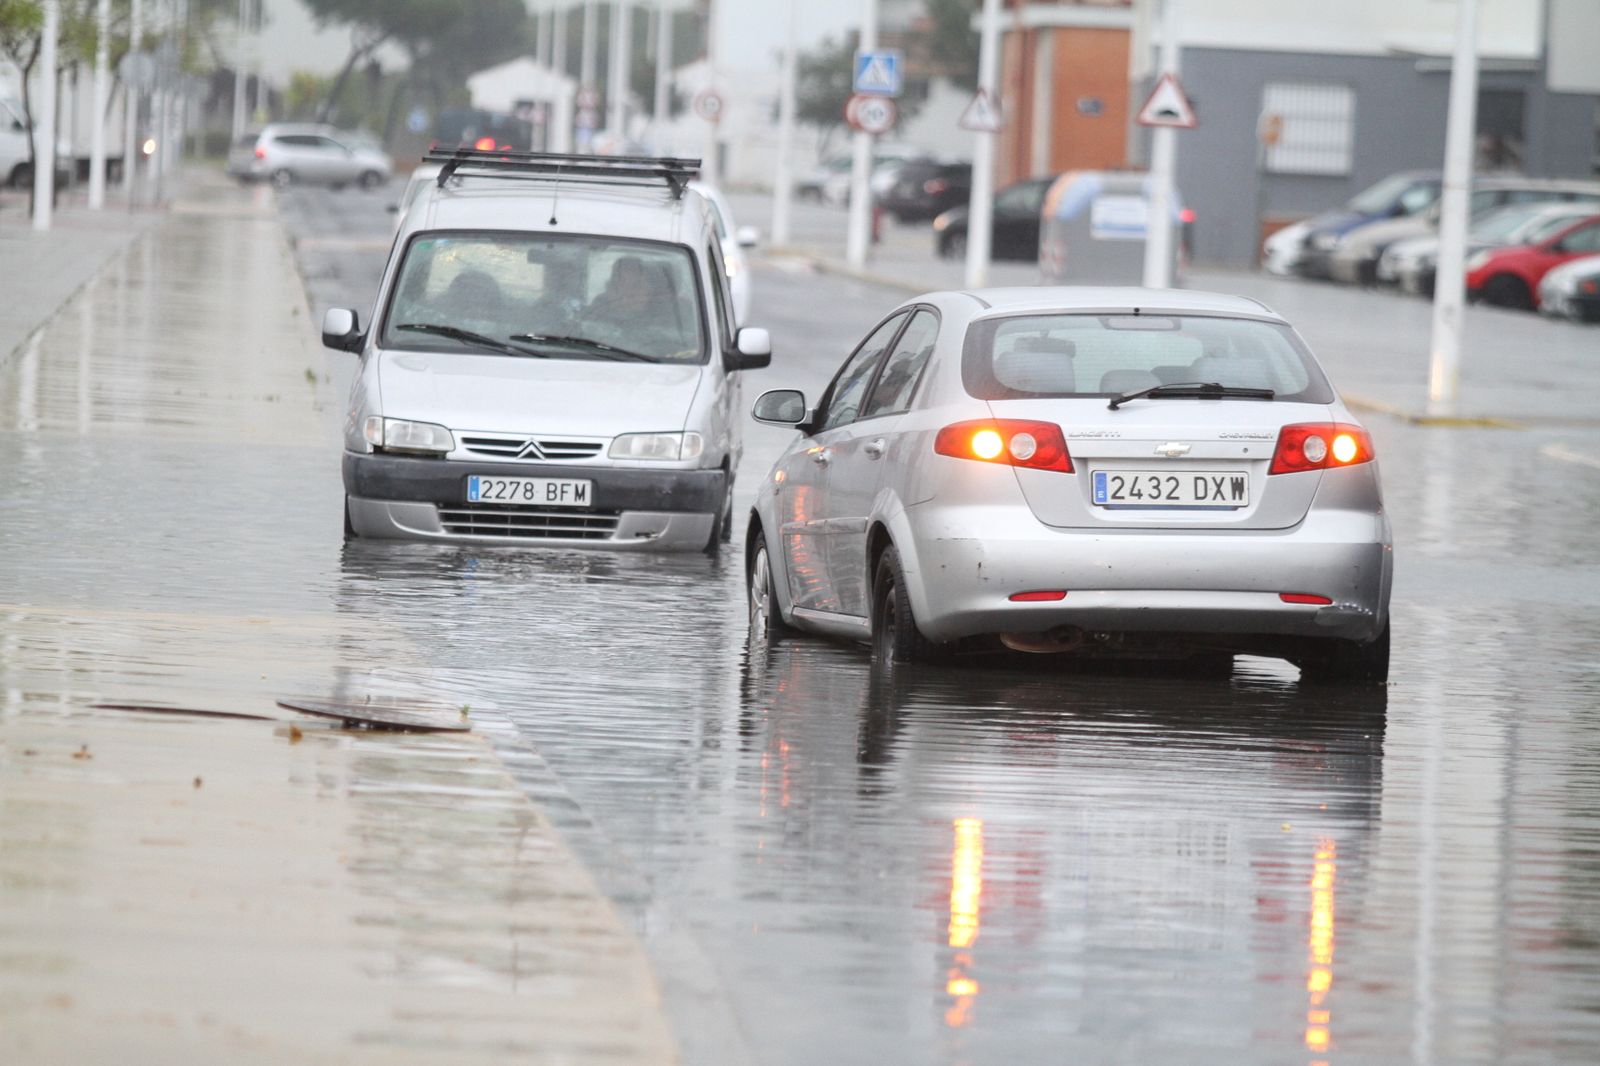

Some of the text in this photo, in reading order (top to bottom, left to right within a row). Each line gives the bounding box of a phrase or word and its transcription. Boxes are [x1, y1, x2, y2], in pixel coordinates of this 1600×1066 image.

[481, 480, 586, 502] 2278 BFM
[1110, 476, 1245, 501] 2432 DXW
